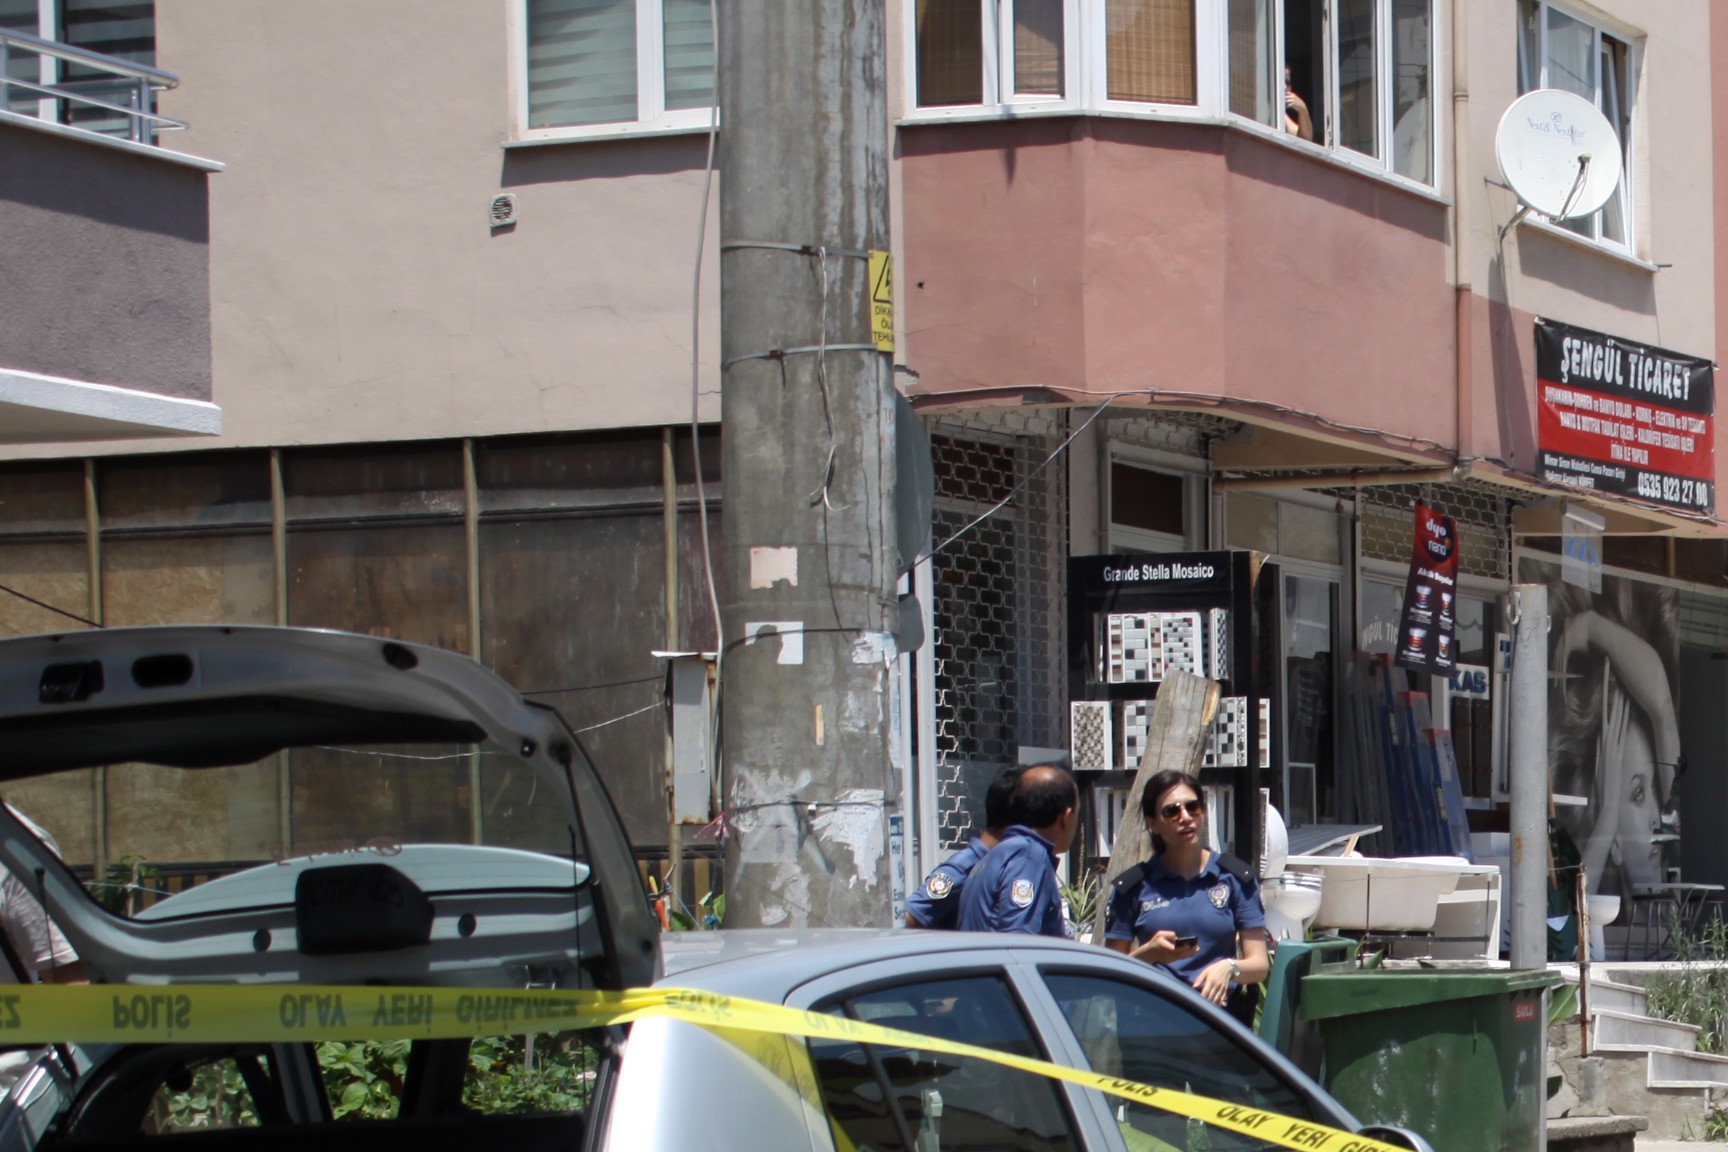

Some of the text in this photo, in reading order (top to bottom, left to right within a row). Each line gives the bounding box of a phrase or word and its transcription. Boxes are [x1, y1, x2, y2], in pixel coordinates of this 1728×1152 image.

[1561, 337, 1691, 400] ŞENGÜL TİCARET
[1638, 471, 1661, 498] 0535
[1662, 477, 1680, 502] 923
[1682, 480, 1693, 504] 27
[1426, 518, 1446, 538] dyo
[1104, 562, 1214, 582] Grande Stella Mosaico
[1216, 1106, 1273, 1129] OLAY
[1281, 1123, 1337, 1148] YERİ
